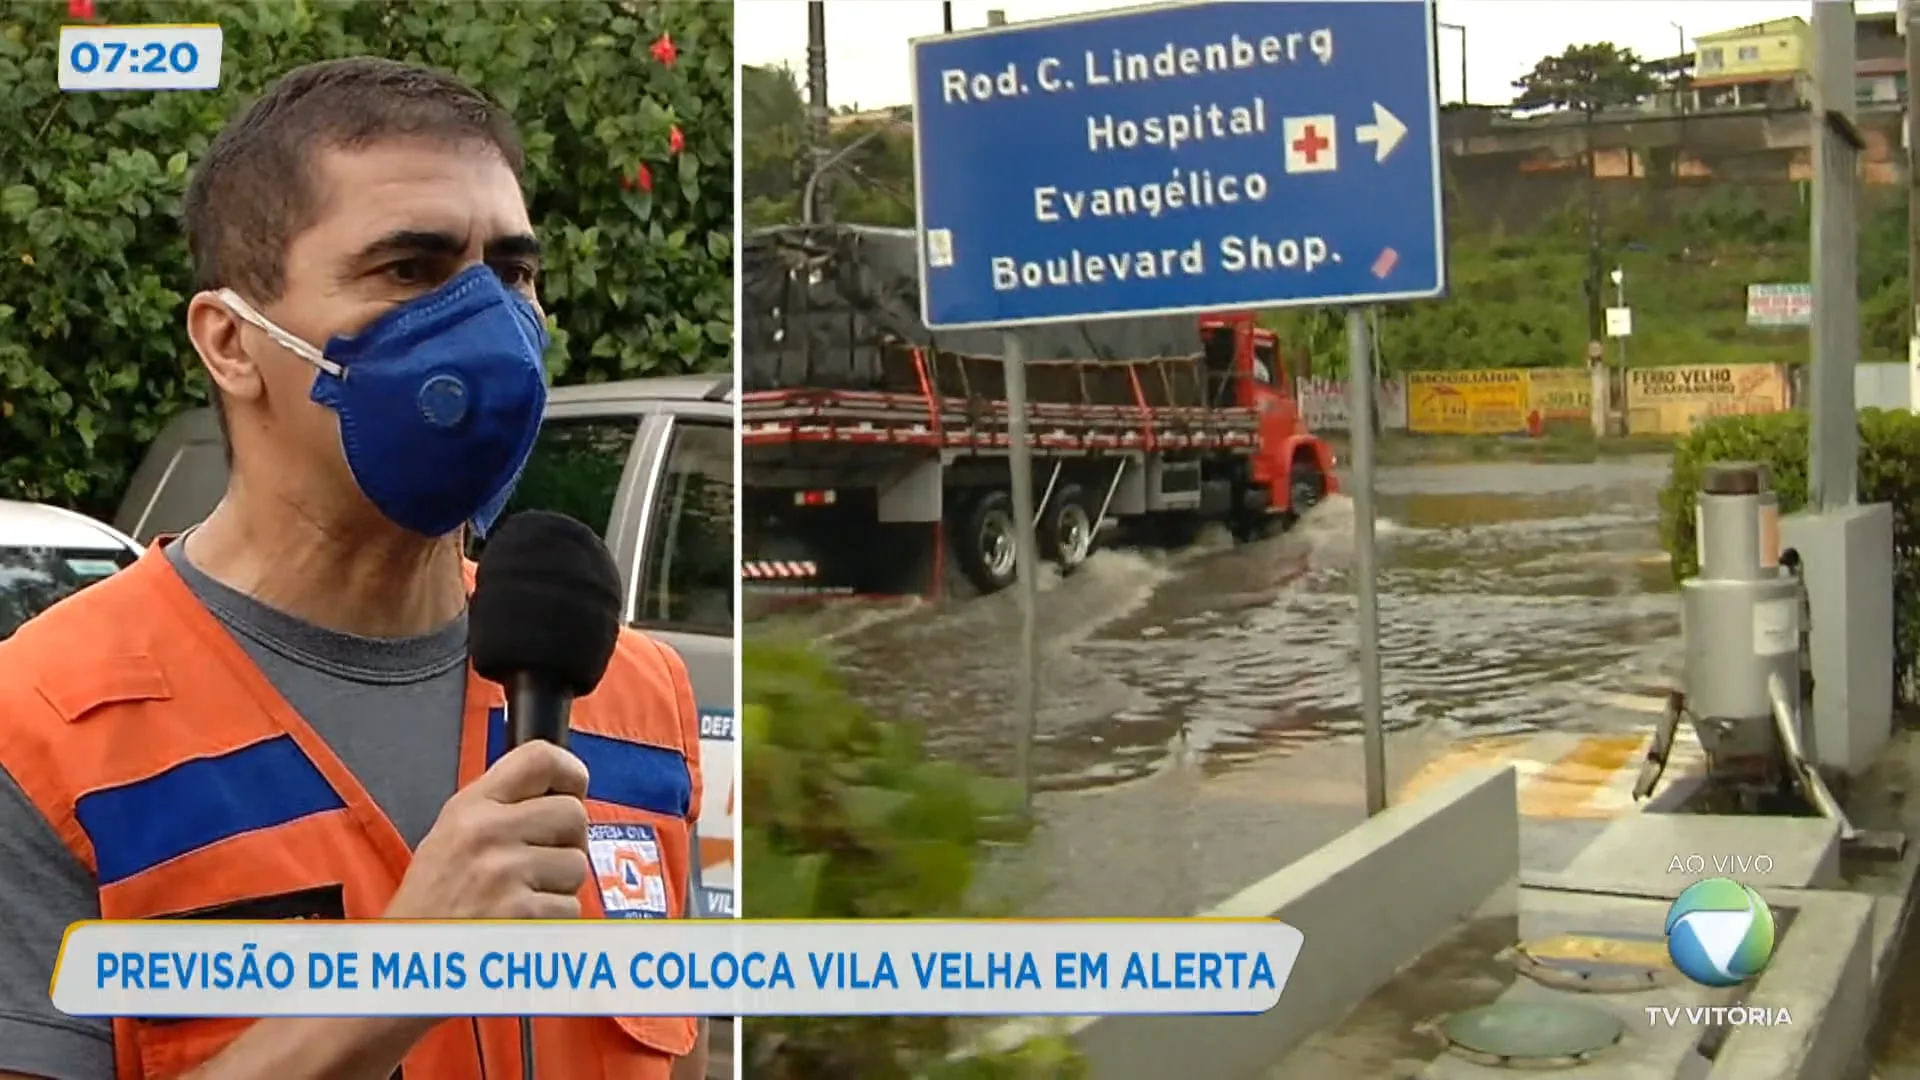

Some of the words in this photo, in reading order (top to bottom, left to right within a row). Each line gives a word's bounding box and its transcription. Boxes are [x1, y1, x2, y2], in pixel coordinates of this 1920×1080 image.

[942, 64, 1029, 103] Rod.
[1037, 57, 1074, 91] C.
[1085, 27, 1333, 86] Lindenberg
[1087, 97, 1265, 152] Hospital
[1035, 168, 1267, 221] Evangélico
[992, 241, 1203, 290] Boulevard
[1221, 236, 1341, 278] Shop.
[1681, 368, 1731, 384] VELHO
